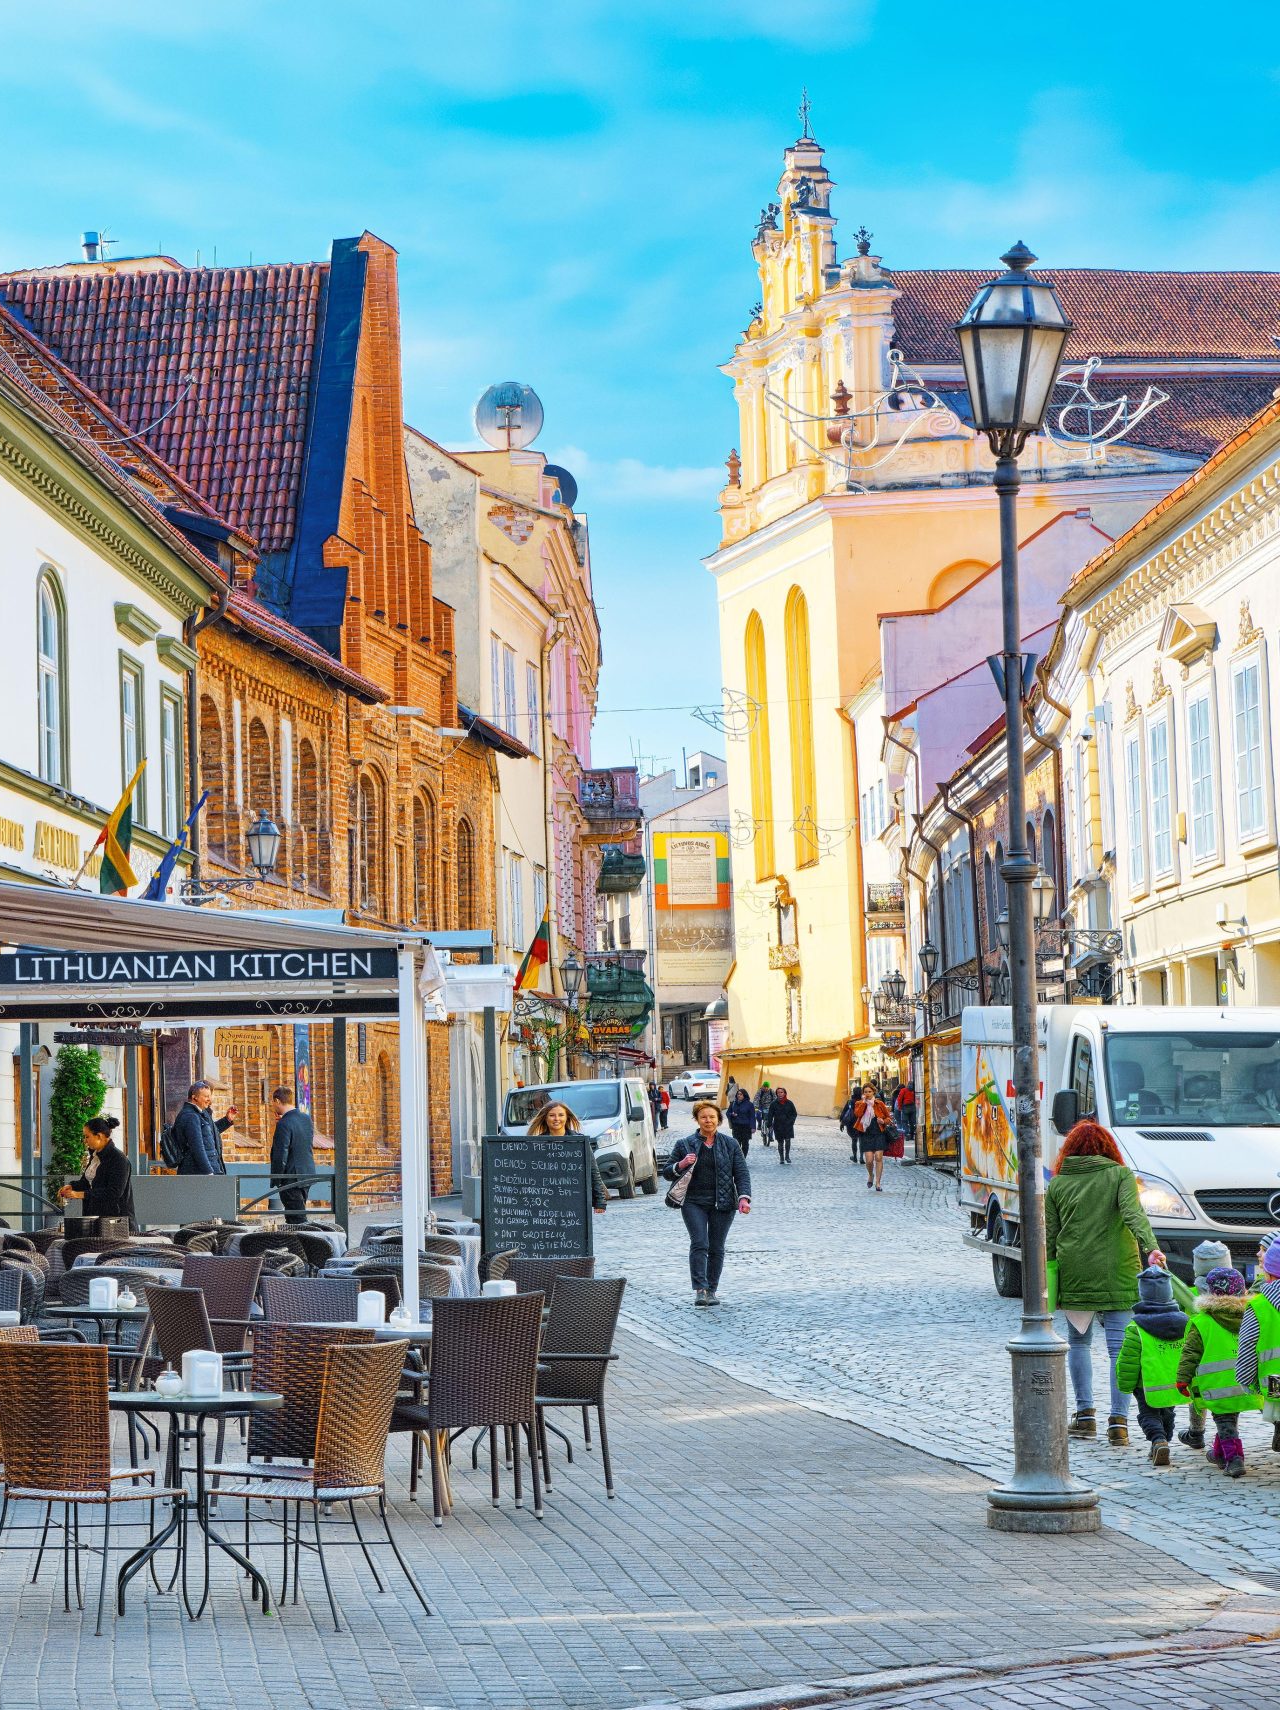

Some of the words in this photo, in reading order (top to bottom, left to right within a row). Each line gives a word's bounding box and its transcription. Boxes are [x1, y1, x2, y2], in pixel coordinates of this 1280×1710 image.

[15, 954, 216, 981] LITHUANIAN
[230, 952, 372, 978] KITCHEN
[593, 1026, 630, 1034] DVARAS
